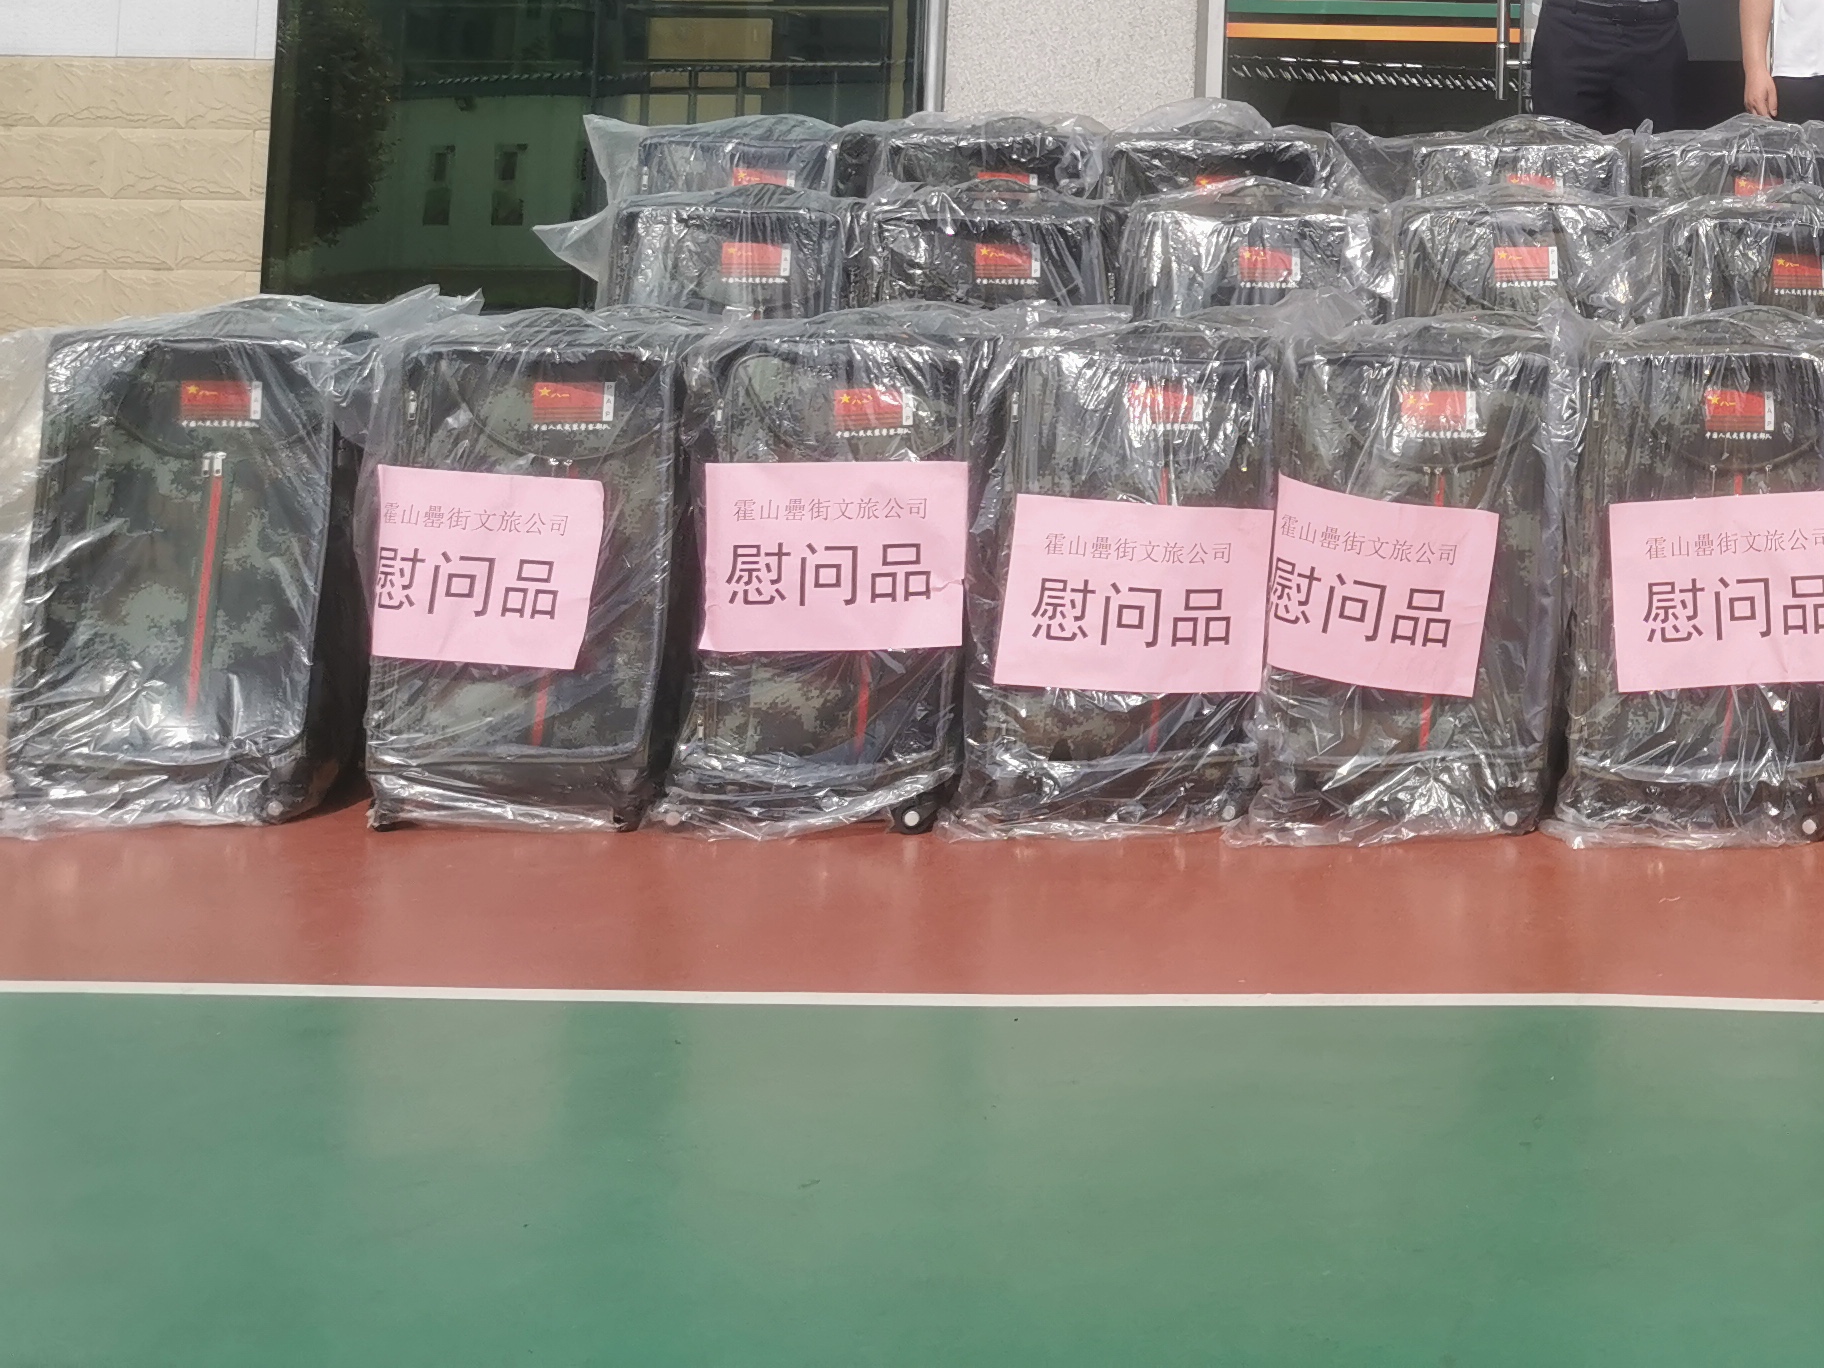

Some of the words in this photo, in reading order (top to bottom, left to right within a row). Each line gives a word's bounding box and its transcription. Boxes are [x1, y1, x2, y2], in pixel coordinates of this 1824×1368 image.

[376, 546, 560, 620] 慰问品
[725, 541, 935, 606] 慰问品
[1267, 556, 1453, 650] 慰问品
[1031, 576, 1234, 648] 慰问品
